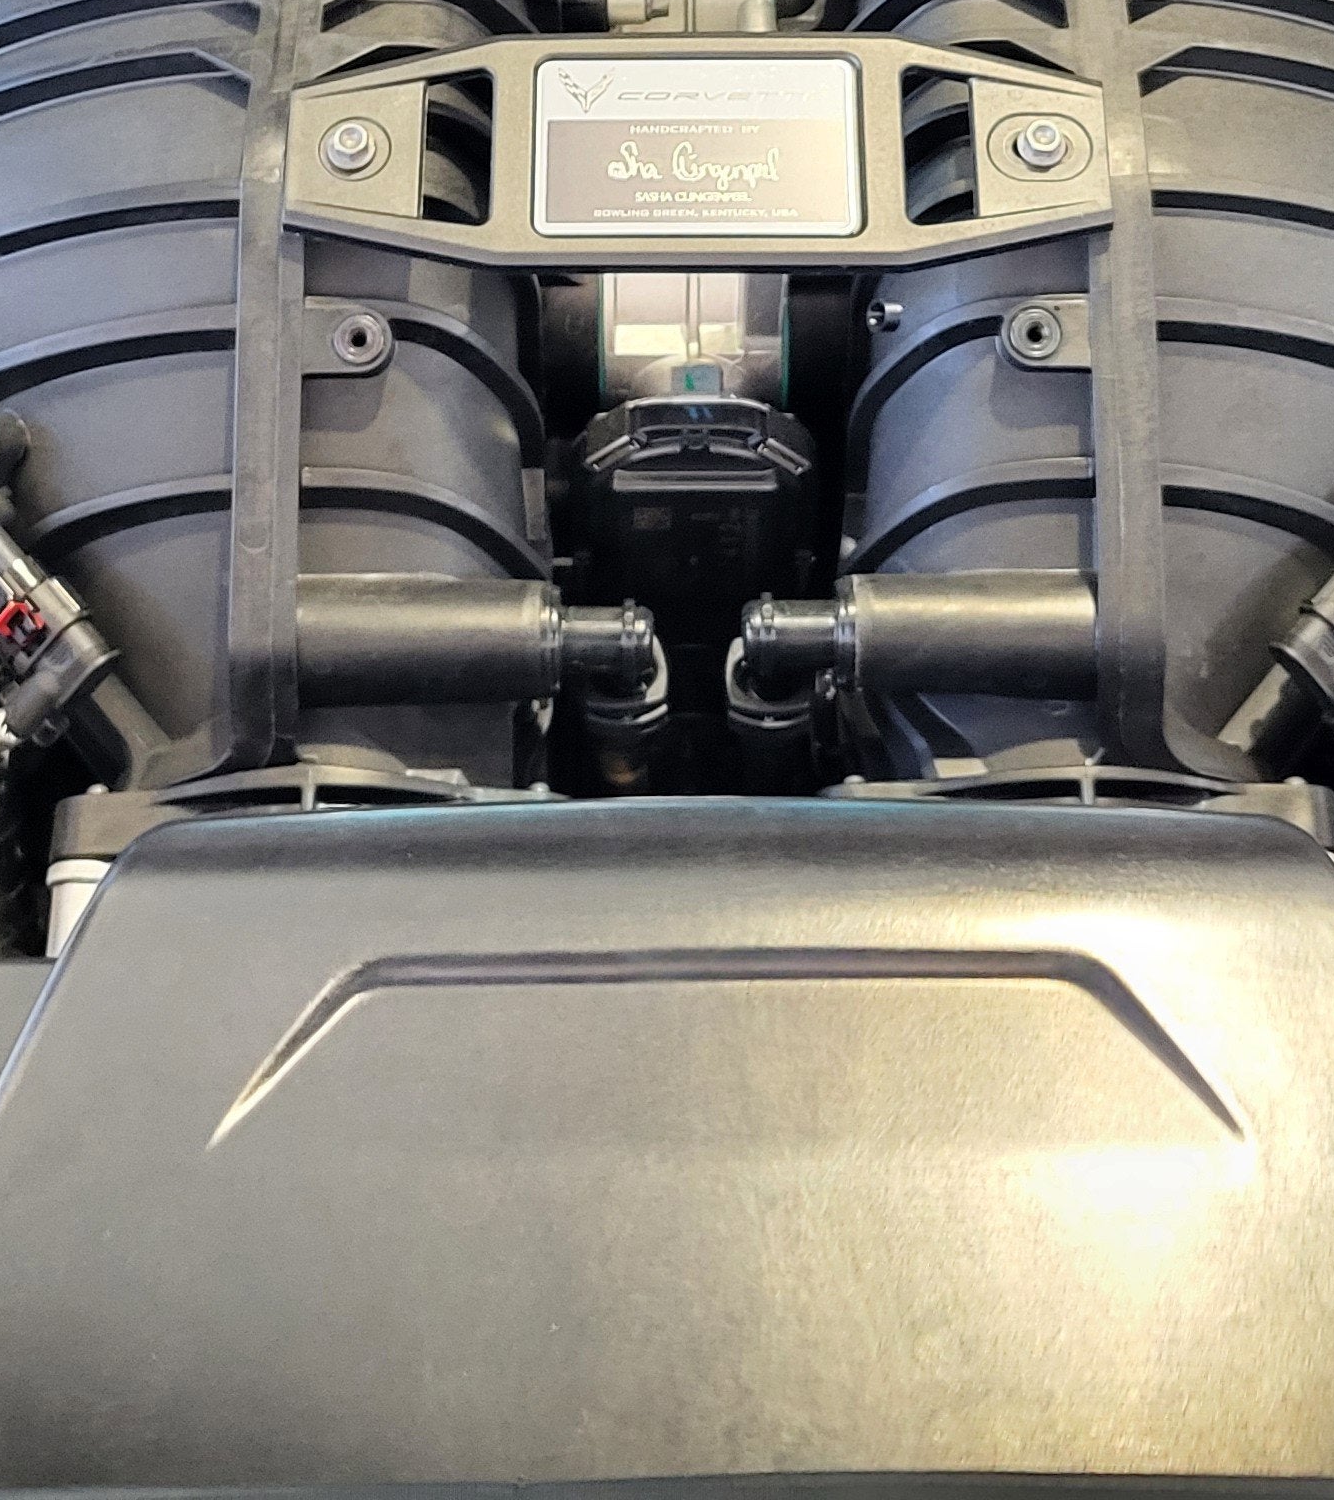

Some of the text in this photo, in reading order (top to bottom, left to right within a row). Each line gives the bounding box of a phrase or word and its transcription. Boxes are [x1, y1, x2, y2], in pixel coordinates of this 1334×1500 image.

[617, 91, 822, 102] CORVETT
[629, 125, 733, 134] HANDCRAFTED
[593, 209, 650, 217] BOWLING
[771, 209, 799, 218] USA
